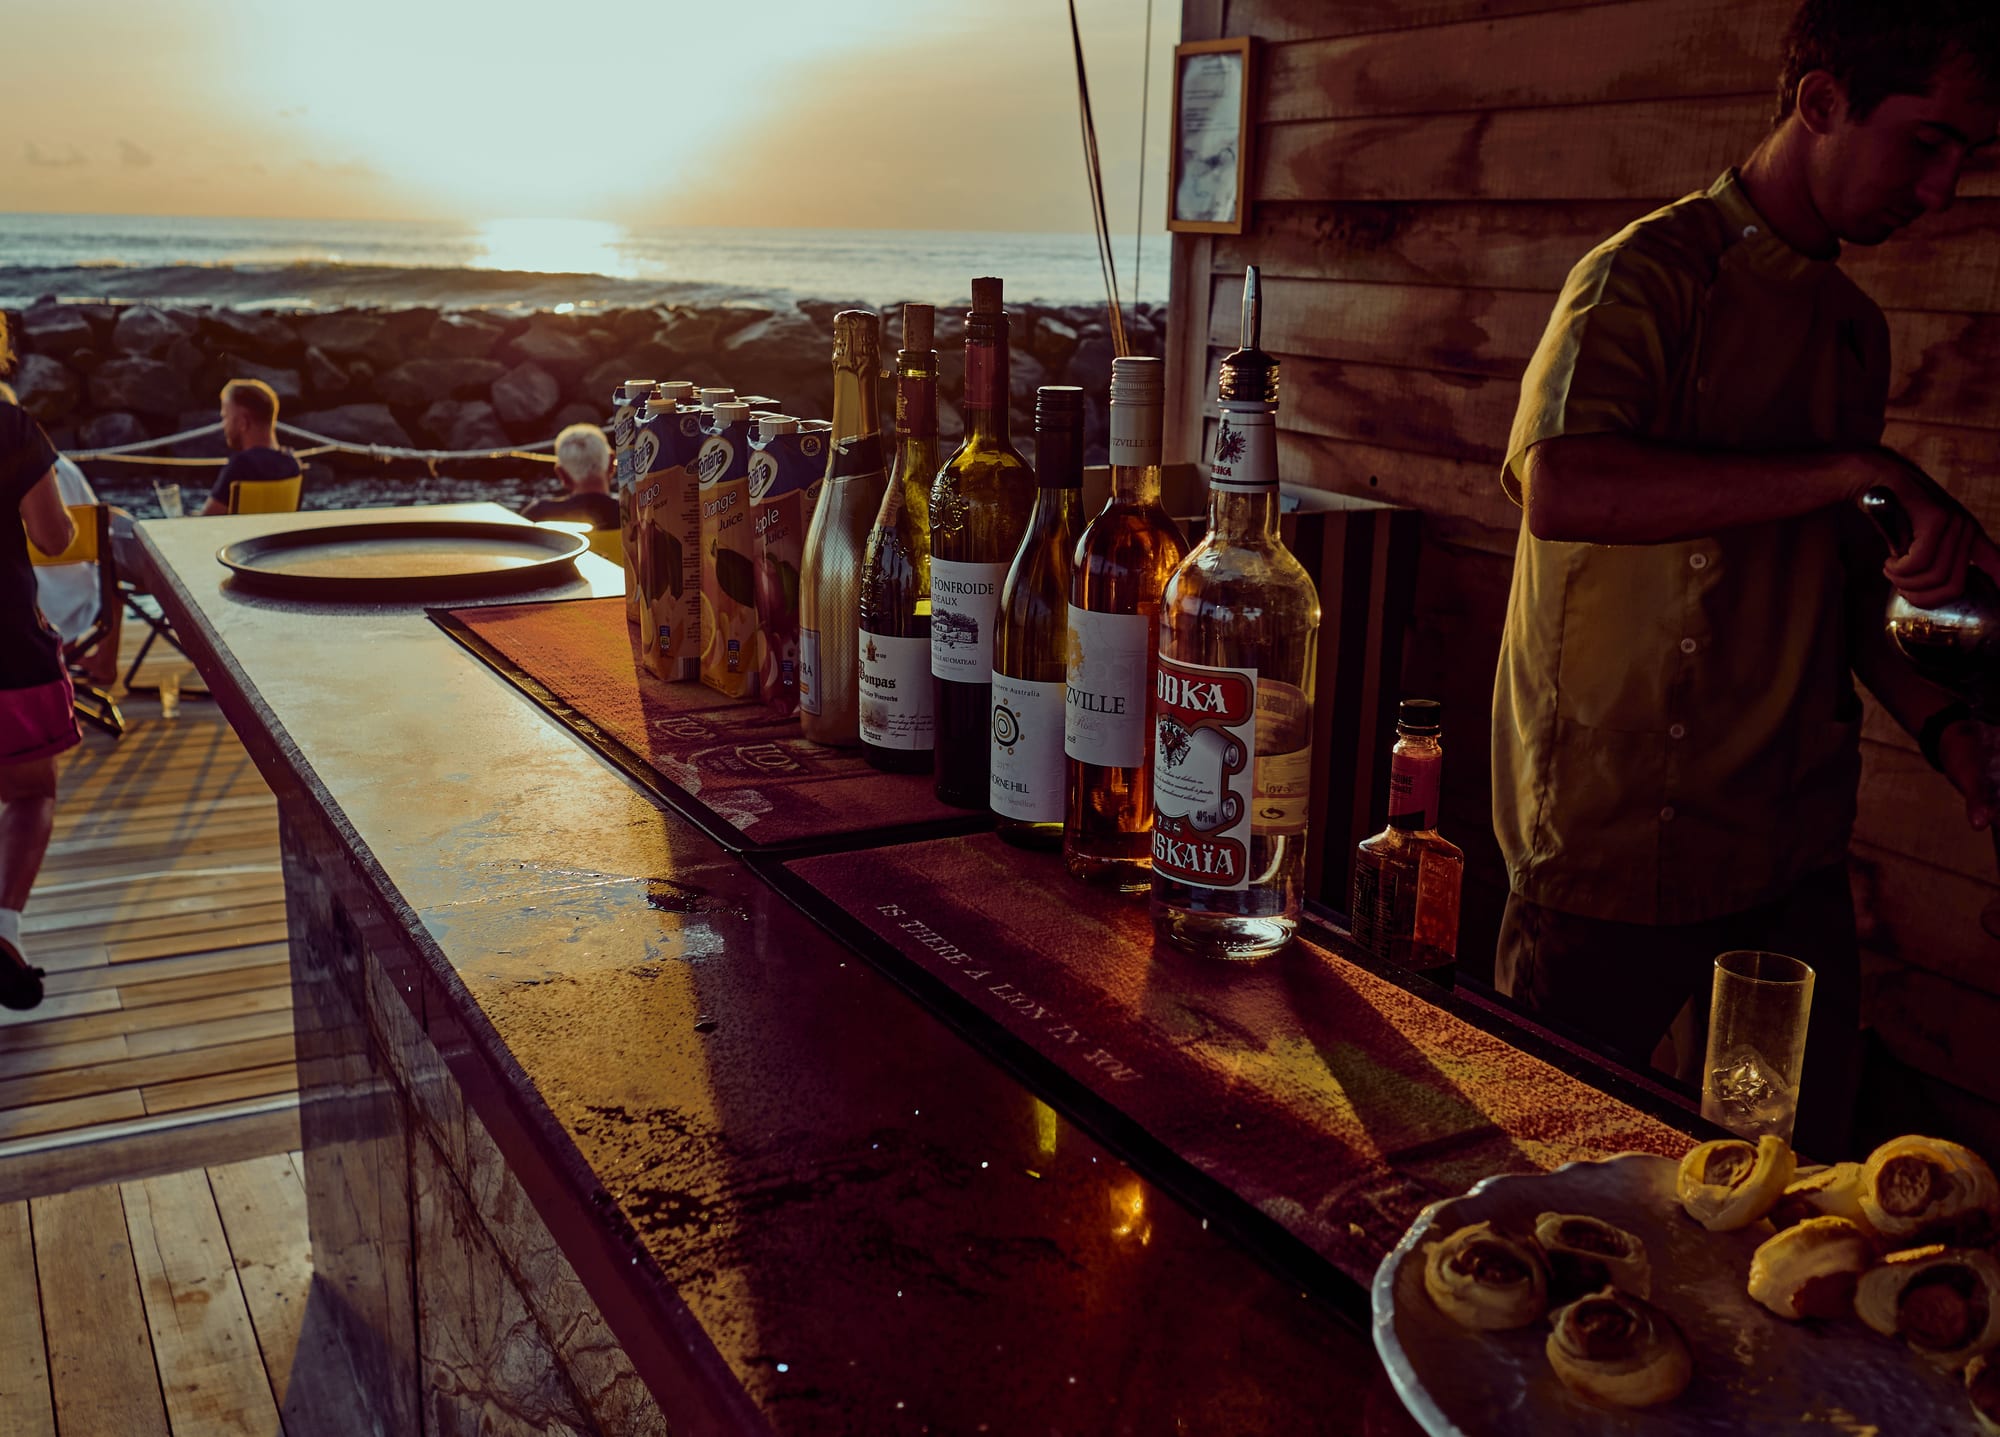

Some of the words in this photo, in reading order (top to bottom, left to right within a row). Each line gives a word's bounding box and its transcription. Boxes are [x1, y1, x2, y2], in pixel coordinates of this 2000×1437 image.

[703, 491, 737, 519] Orange
[719, 512, 744, 531] Juice
[765, 527, 789, 546] Juice
[934, 576, 994, 596] FONFROIDE
[1010, 687, 1040, 698] Australia
[1011, 781, 1030, 794] HILL
[876, 903, 907, 917] IS
[899, 919, 973, 964] THERE
[963, 969, 992, 981] A
[988, 983, 1048, 1020] LION
[1049, 1024, 1088, 1044] IN
[1083, 1047, 1145, 1082] YOU
